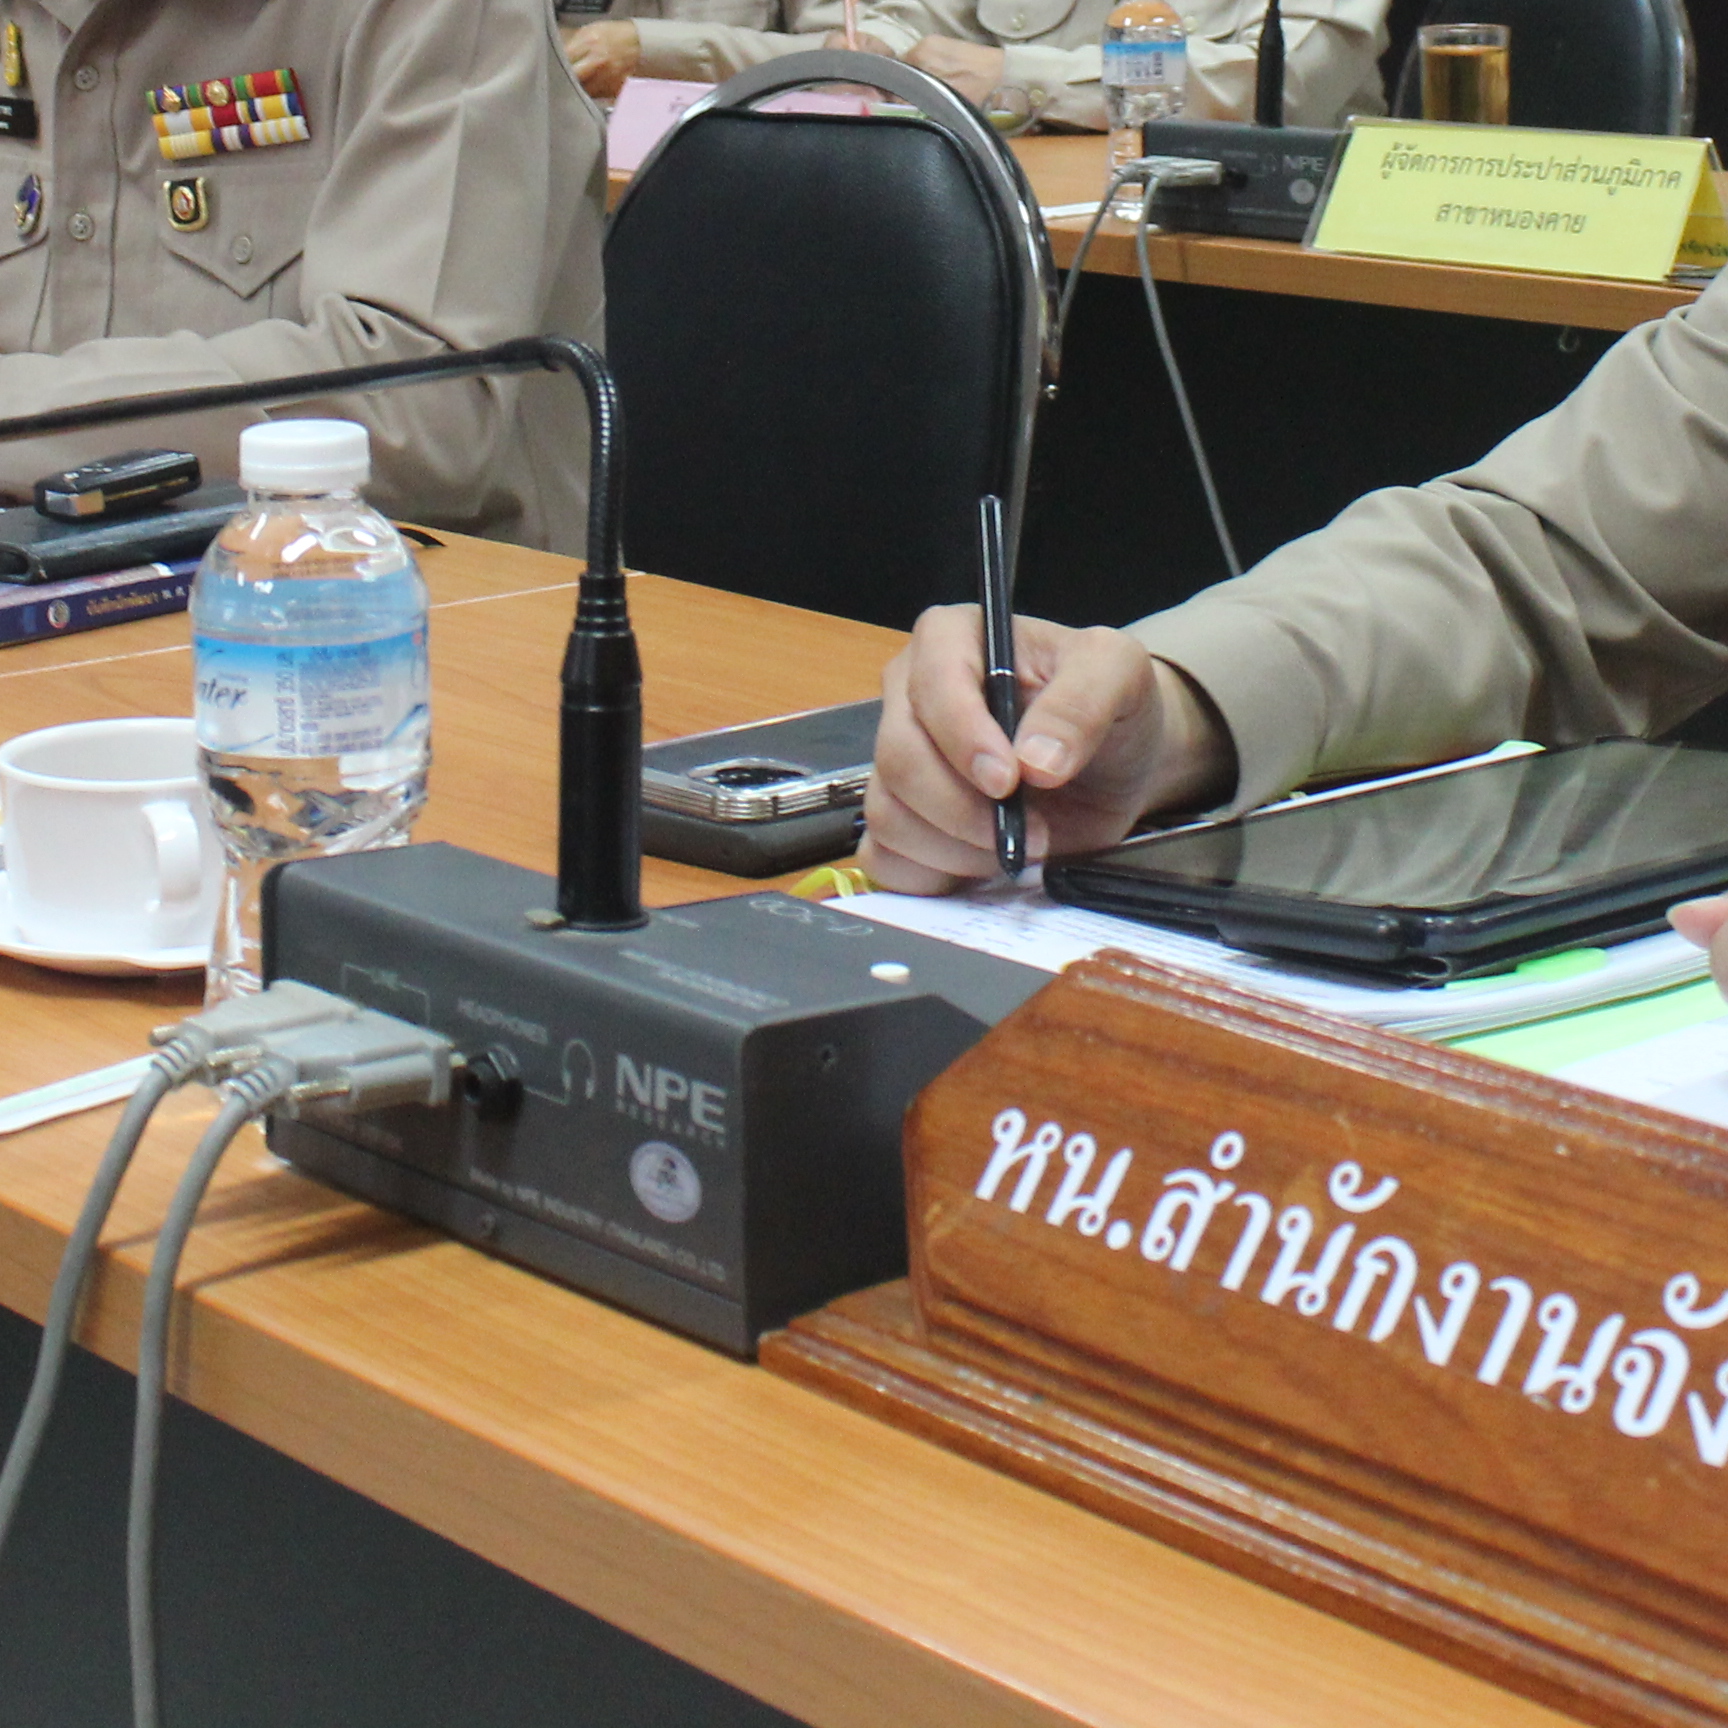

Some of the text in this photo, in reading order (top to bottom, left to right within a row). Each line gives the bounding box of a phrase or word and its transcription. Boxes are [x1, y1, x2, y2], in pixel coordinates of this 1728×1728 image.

[1282, 154, 1326, 172] NPE
[1380, 141, 1683, 195] ผู้จัดการการประปาส่วนภูมิภาค
[1435, 202, 1587, 234] สาขาหนองคาย
[616, 1052, 728, 1135] NPE
